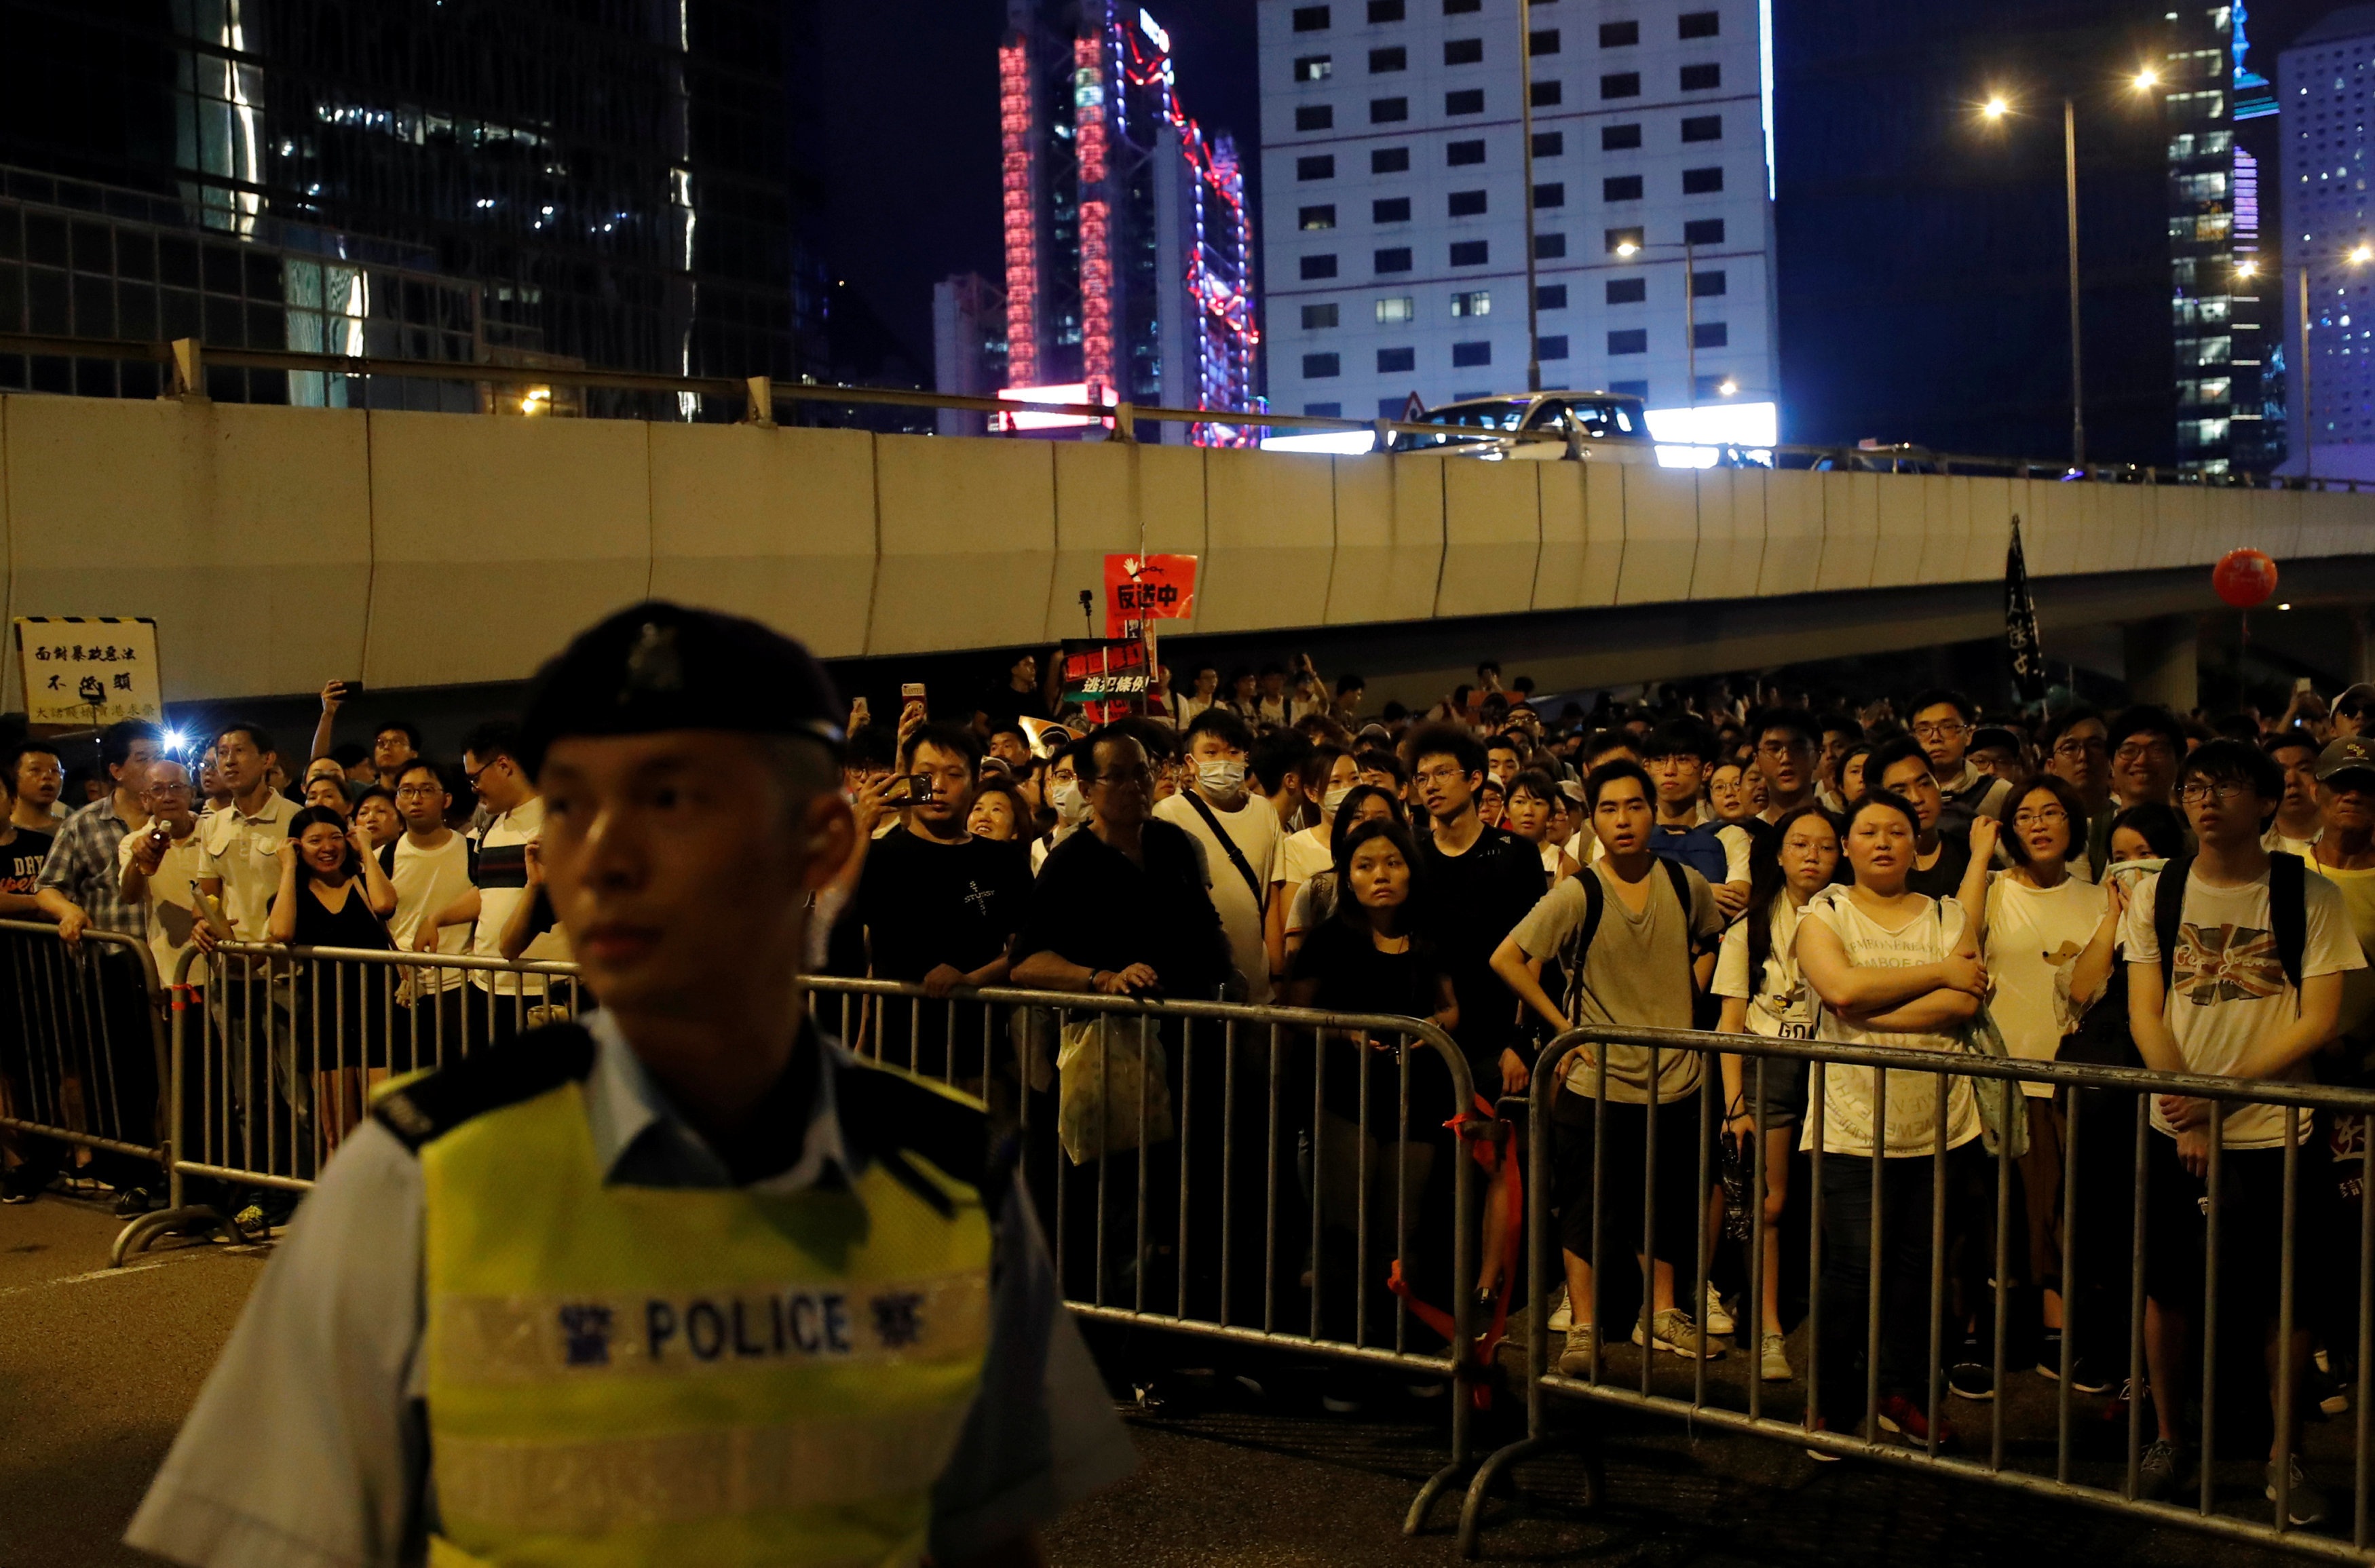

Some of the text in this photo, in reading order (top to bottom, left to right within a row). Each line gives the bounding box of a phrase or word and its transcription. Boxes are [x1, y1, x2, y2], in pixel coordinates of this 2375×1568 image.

[1118, 583, 1177, 609] 反送中
[35, 645, 137, 662] 面對暴政惡法
[48, 672, 132, 693] 不低頭
[1082, 676, 1150, 692] 逃犯條例
[646, 1293, 852, 1362] POLICE
